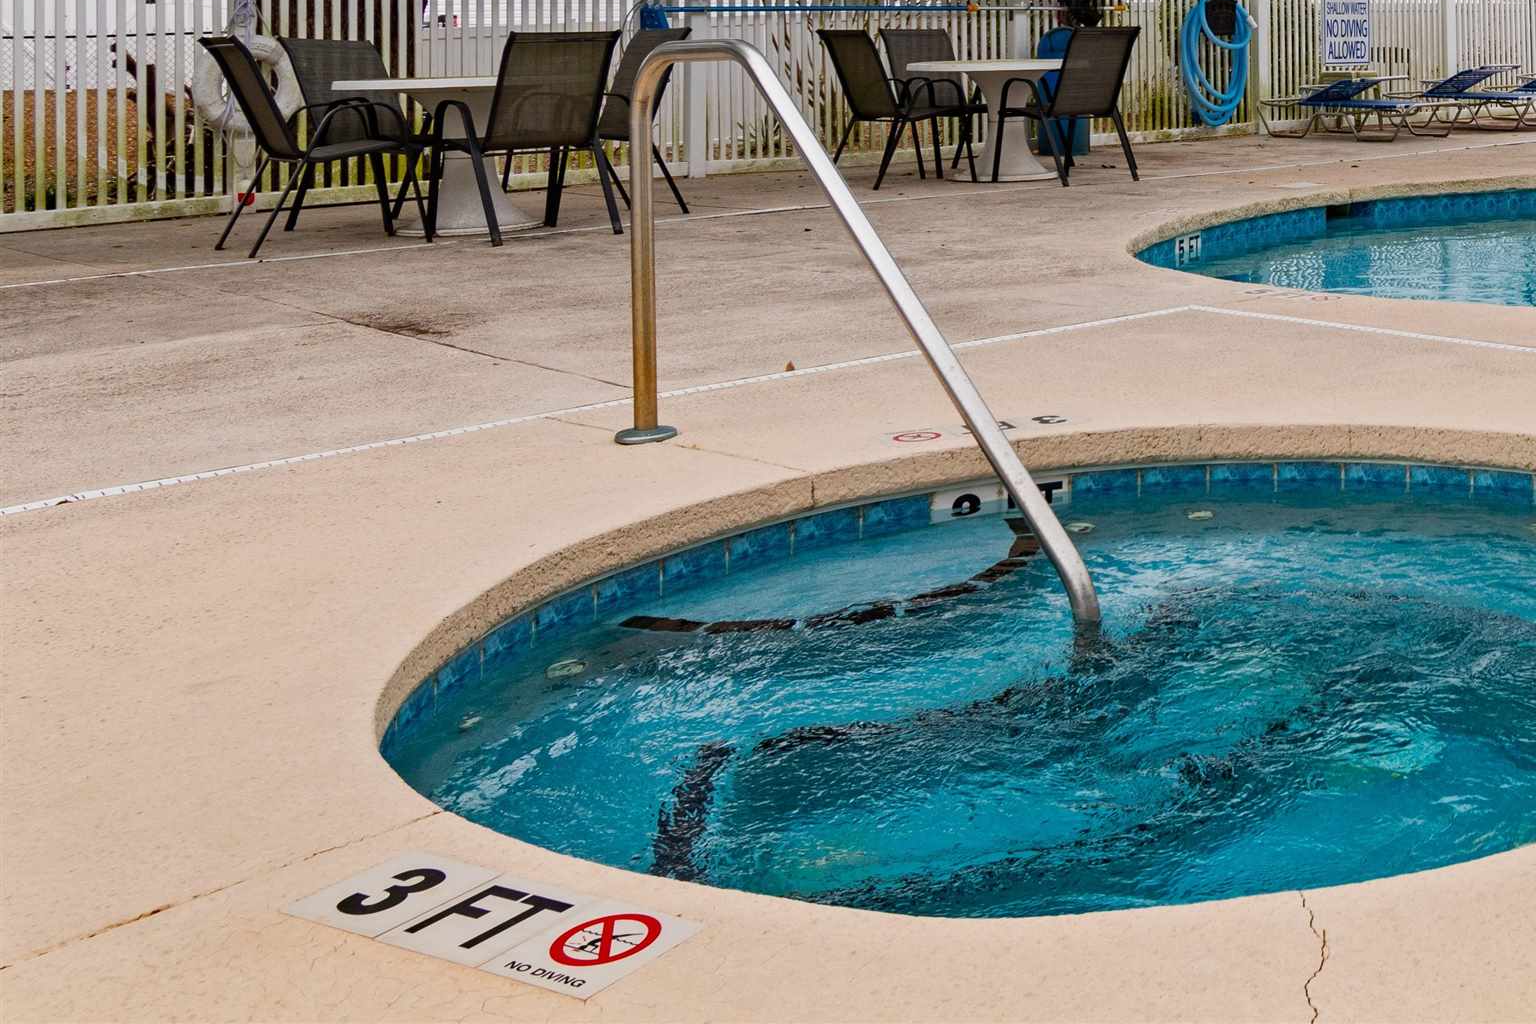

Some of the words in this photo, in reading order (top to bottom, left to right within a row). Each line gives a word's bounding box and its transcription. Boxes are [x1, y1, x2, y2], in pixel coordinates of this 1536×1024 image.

[1326, 2, 1350, 15] SHALLOW
[1350, 2, 1367, 15] WATER
[1326, 19, 1339, 38] NO
[1341, 19, 1368, 38] DIVING
[1328, 41, 1366, 59] ALLOWED
[336, 868, 447, 916] 3
[403, 885, 575, 950] FT
[504, 959, 530, 974] NO
[529, 967, 586, 988] DIVING
